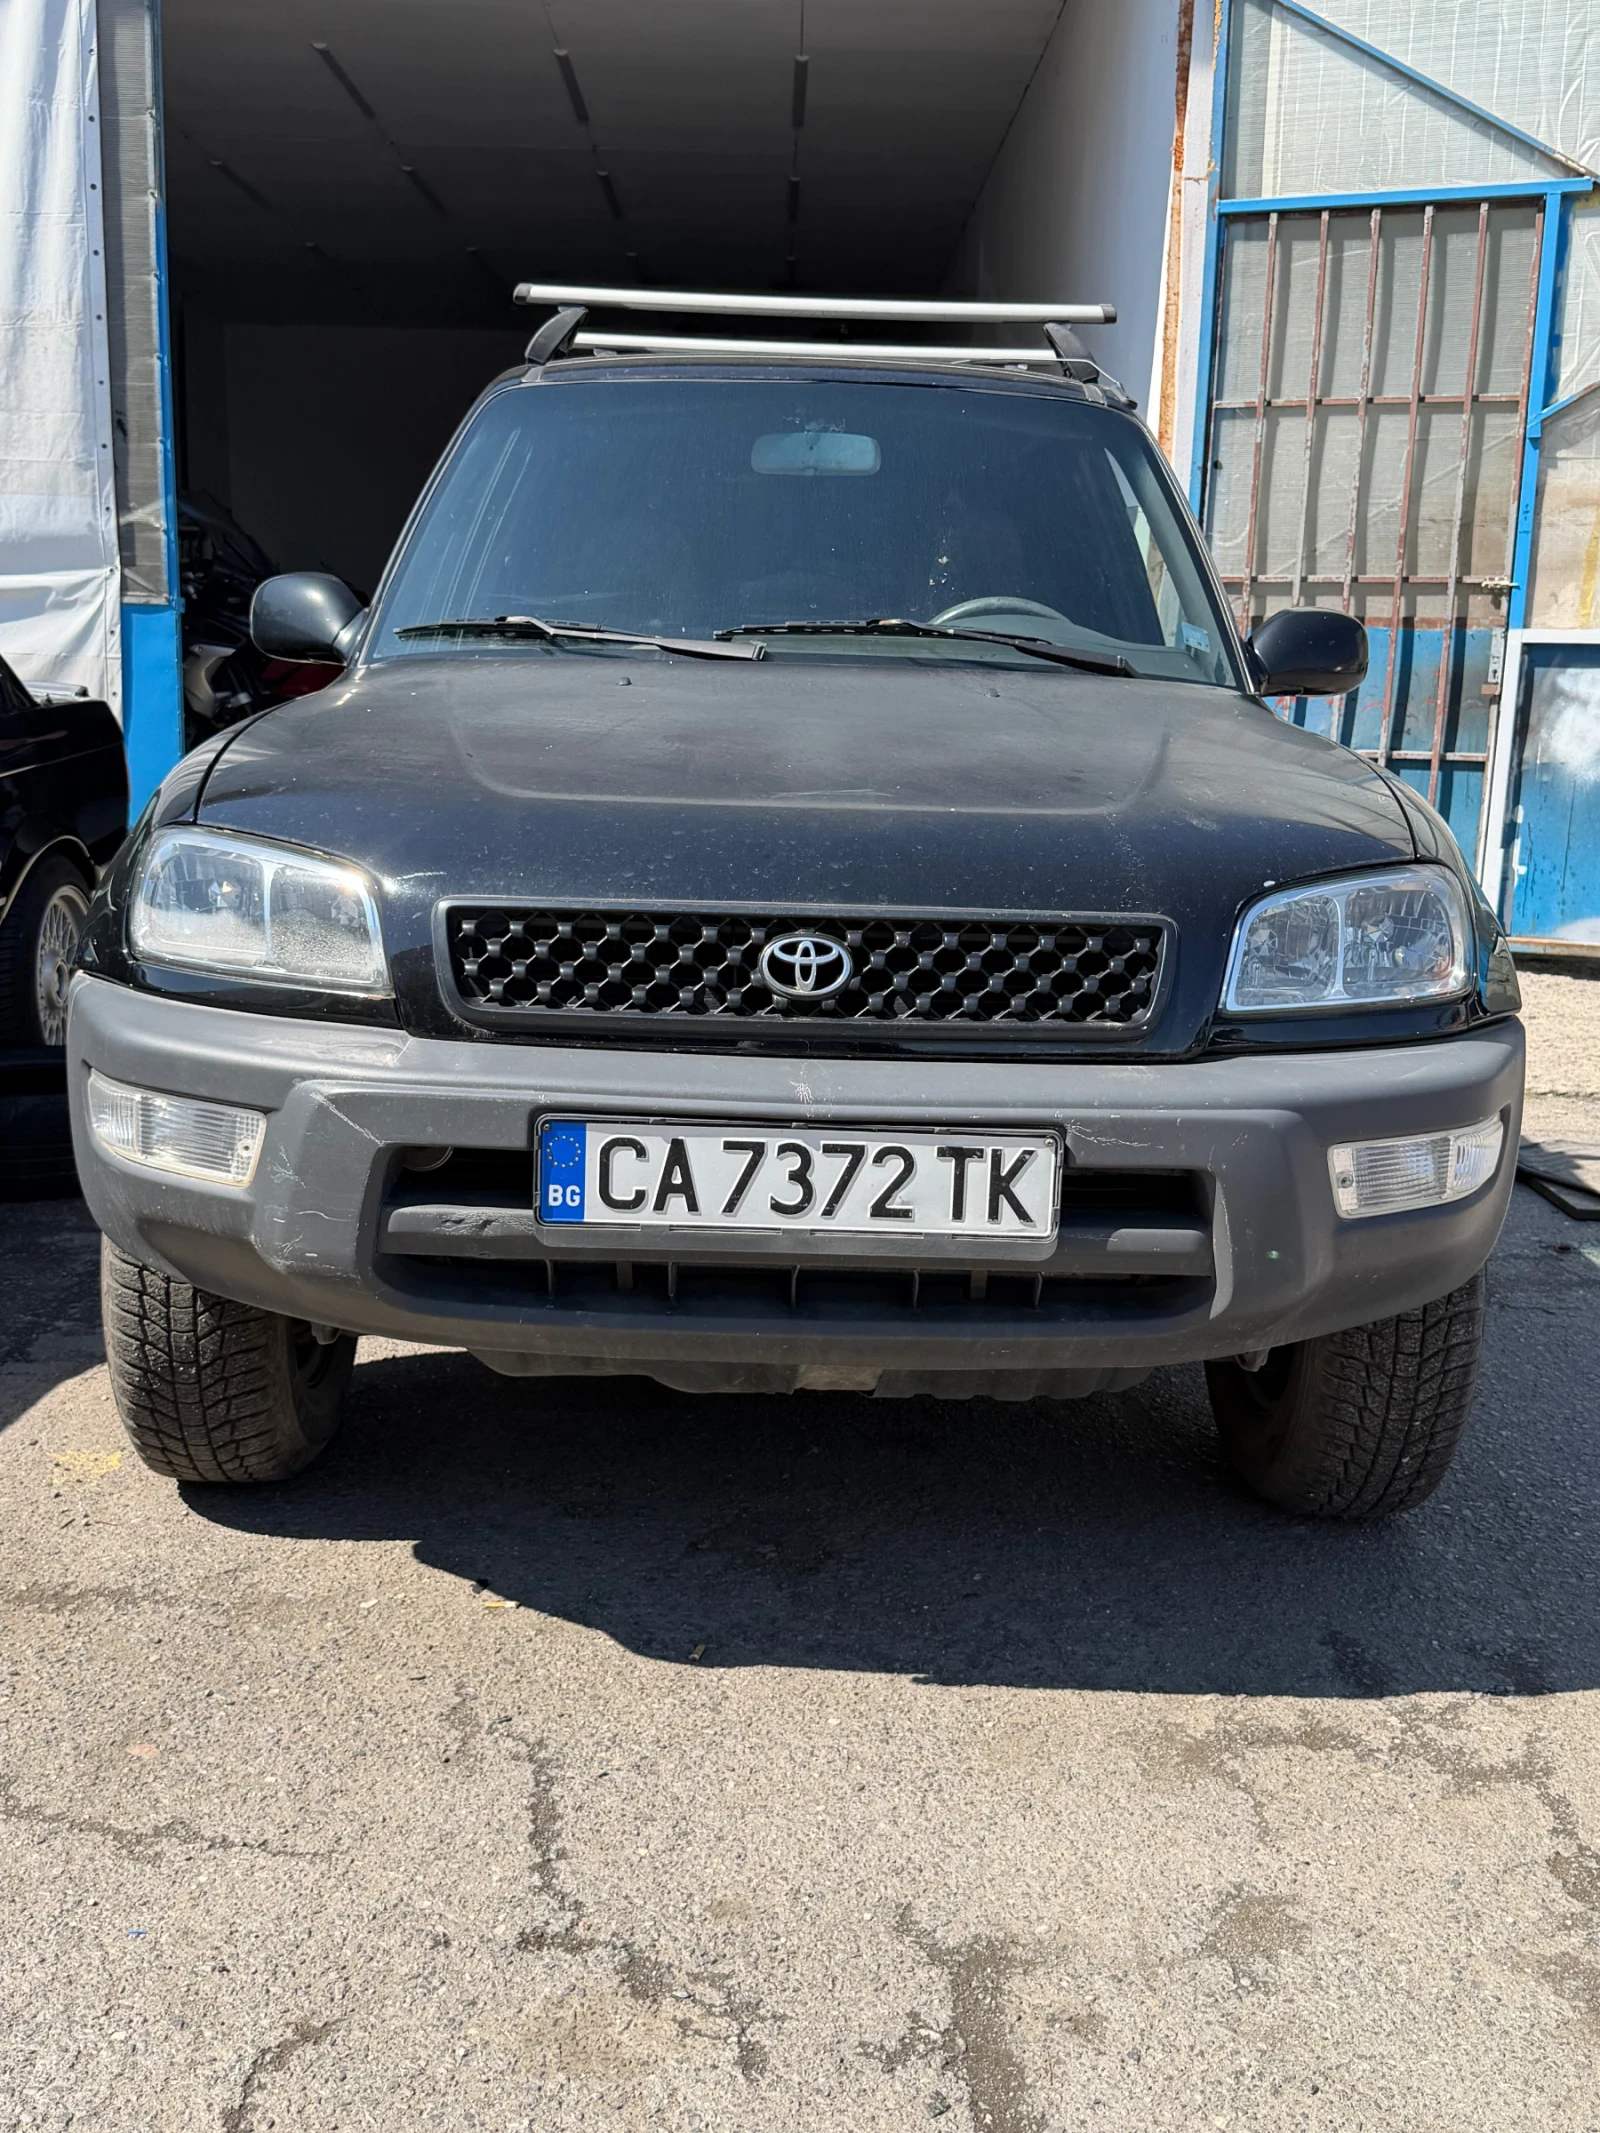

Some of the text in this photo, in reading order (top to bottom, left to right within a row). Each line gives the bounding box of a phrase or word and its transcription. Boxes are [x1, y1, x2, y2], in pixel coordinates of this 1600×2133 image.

[548, 1185, 581, 1207] BG
[598, 1137, 1035, 1223] CA 7372 TK
